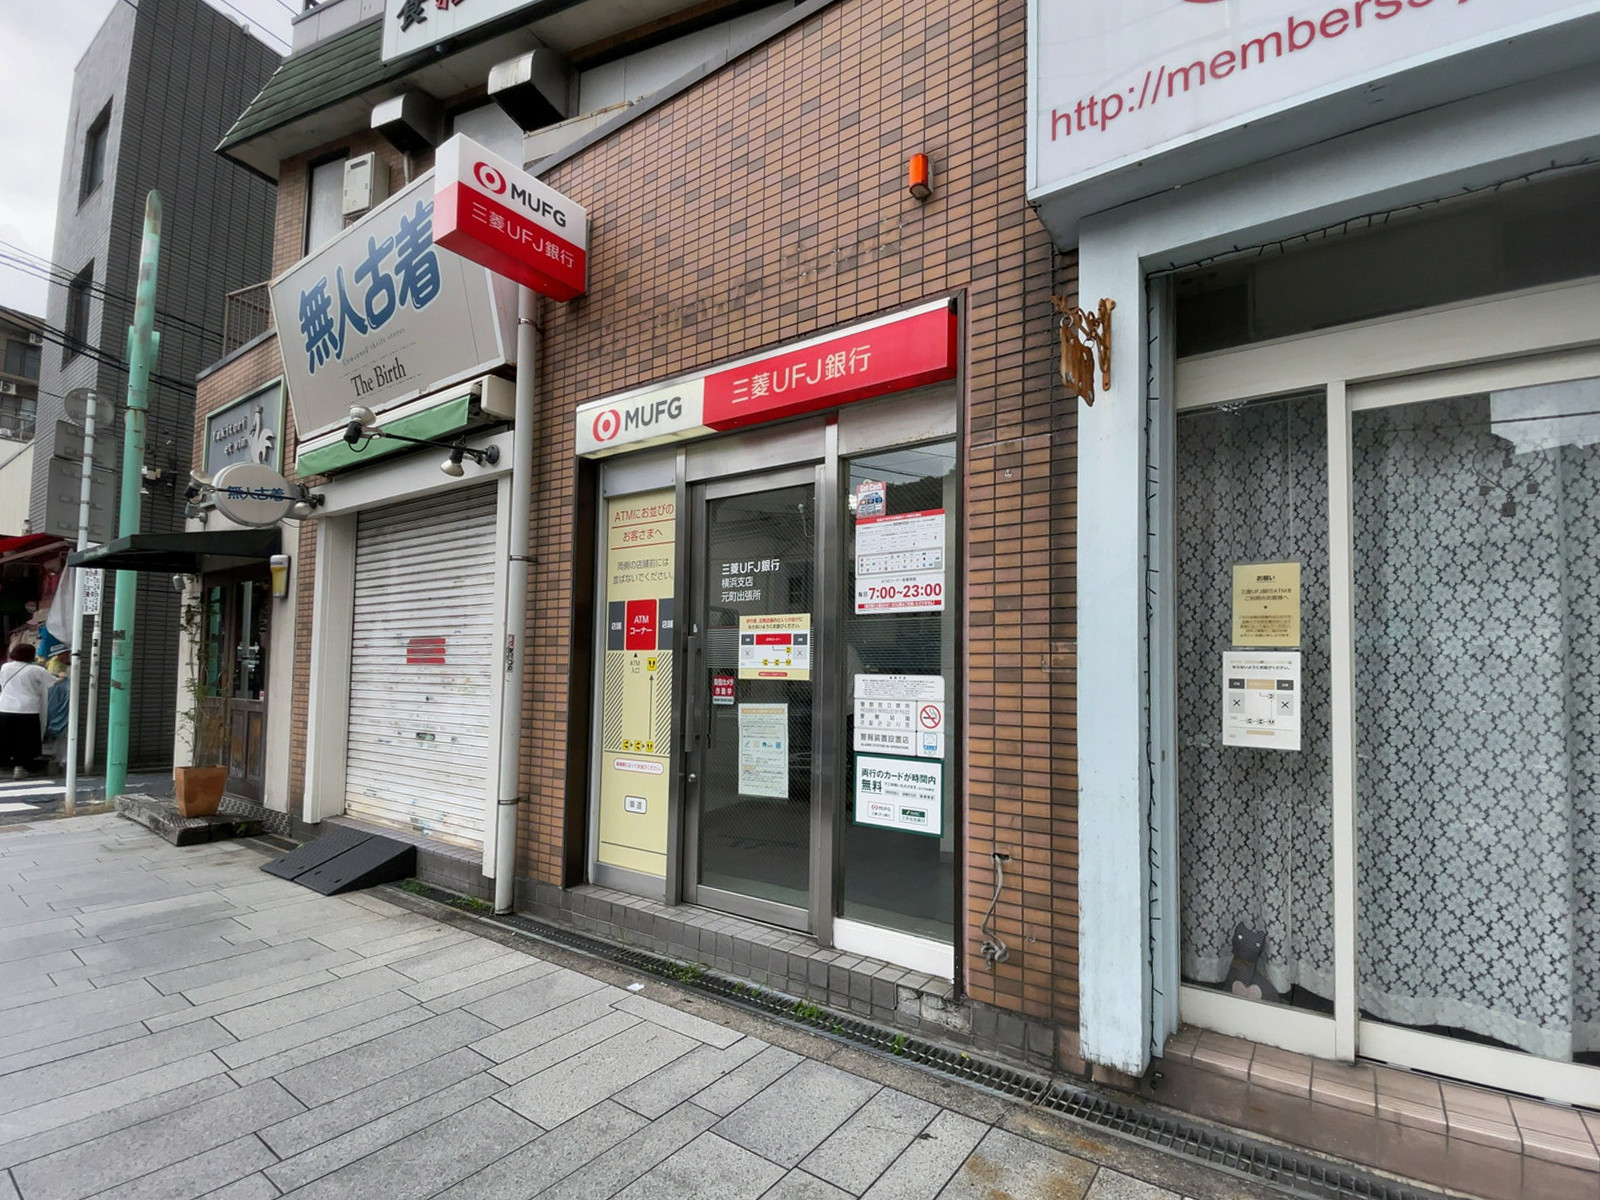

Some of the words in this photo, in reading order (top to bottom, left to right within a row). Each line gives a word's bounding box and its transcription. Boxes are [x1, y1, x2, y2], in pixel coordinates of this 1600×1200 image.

[1050, 0, 1470, 141] http://members
[511, 182, 566, 227] MUFG
[472, 201, 574, 268] 三菱UFJ銀行
[299, 200, 441, 375] 無人古着
[350, 373, 374, 397] The
[373, 356, 407, 388] Birth
[731, 344, 872, 404] 三菱UFJ銀行
[624, 396, 683, 432] MUFG
[614, 503, 675, 522] ATMにお並びの
[622, 528, 663, 542] お客さまへ
[617, 558, 669, 572] 両側の店舗前には
[722, 558, 780, 575] 三菱UFJ銀行
[612, 573, 675, 585] 並ばないでください。
[721, 576, 754, 588] 横浜支店
[721, 589, 762, 603] 元町出張所
[633, 615, 649, 625] ATM
[629, 627, 653, 635] コーナー
[861, 768, 936, 785] 両行のカードが時間内
[861, 779, 882, 793] 無料
